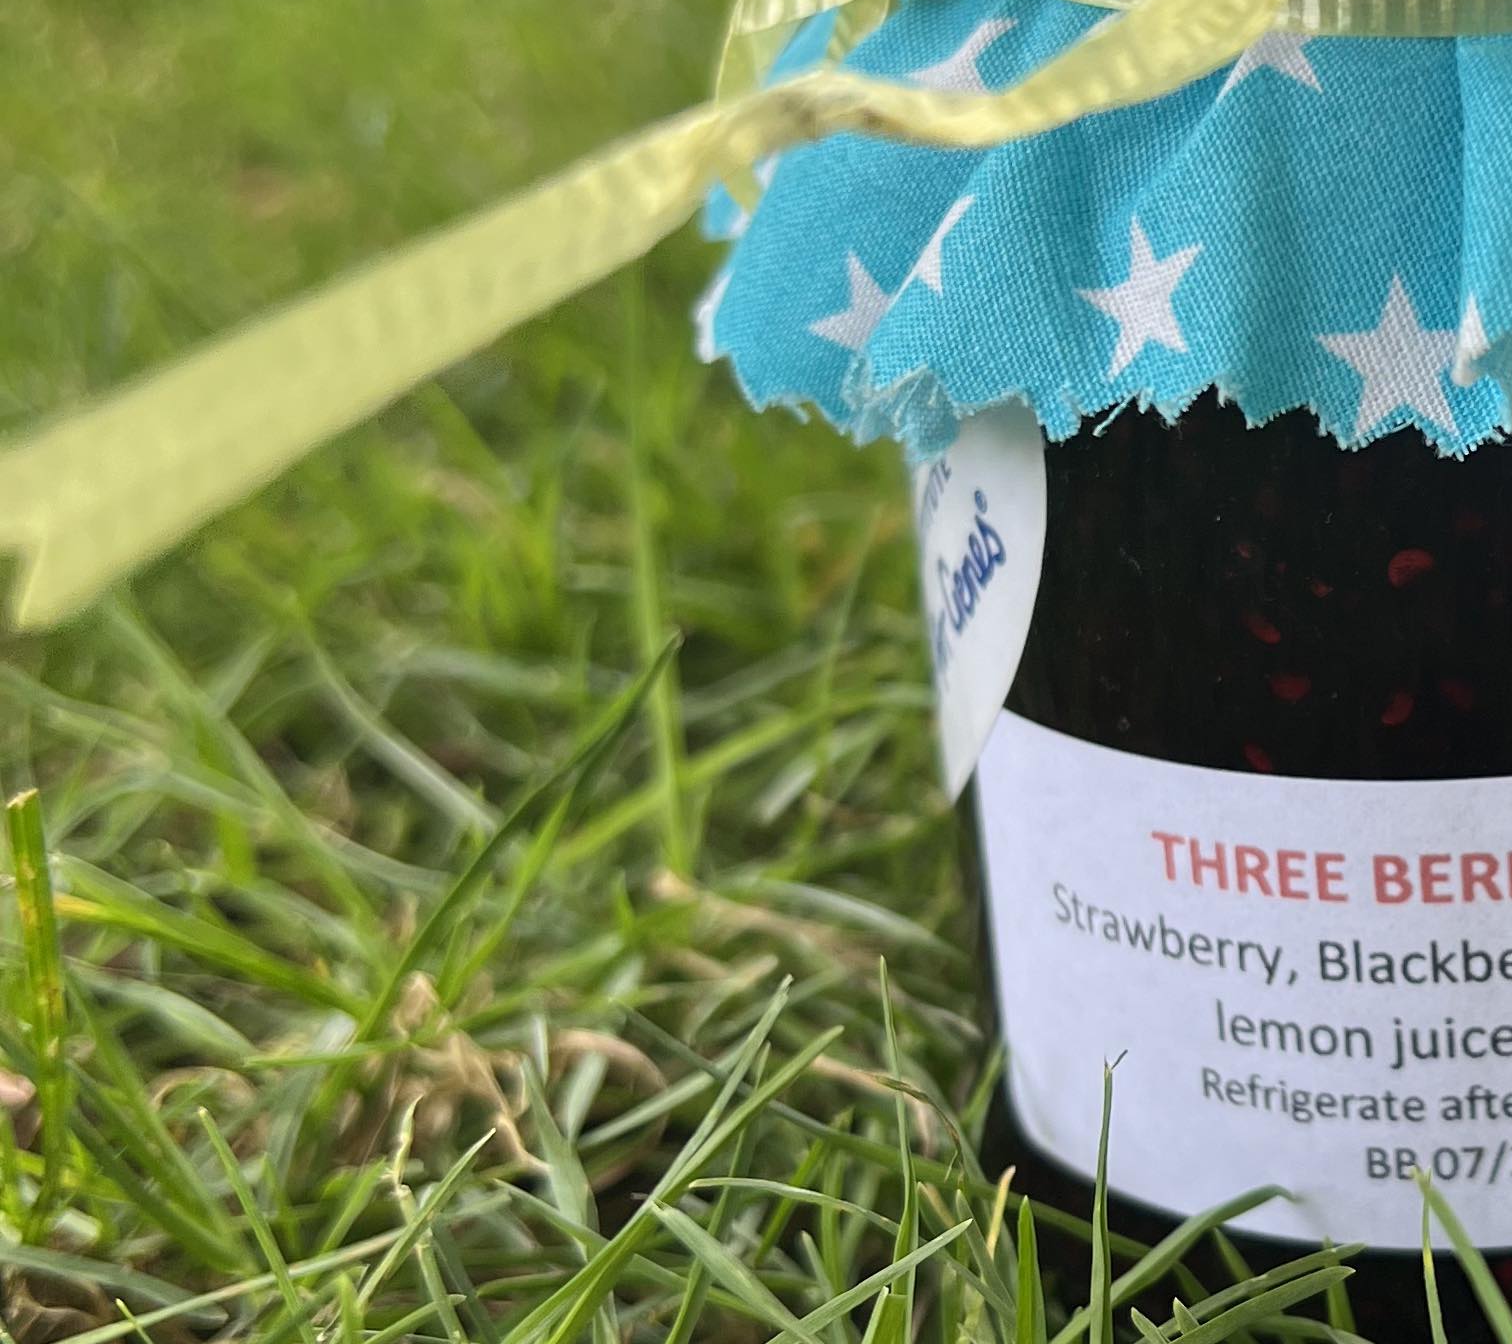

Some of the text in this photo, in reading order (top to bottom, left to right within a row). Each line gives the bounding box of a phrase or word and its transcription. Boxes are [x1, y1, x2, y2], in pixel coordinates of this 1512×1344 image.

[1151, 830, 1349, 903] THREE
[1052, 882, 1299, 987] Strawberry,
[1214, 998, 1374, 1058] lemon
[1200, 1066, 1426, 1124] Refrigerate
